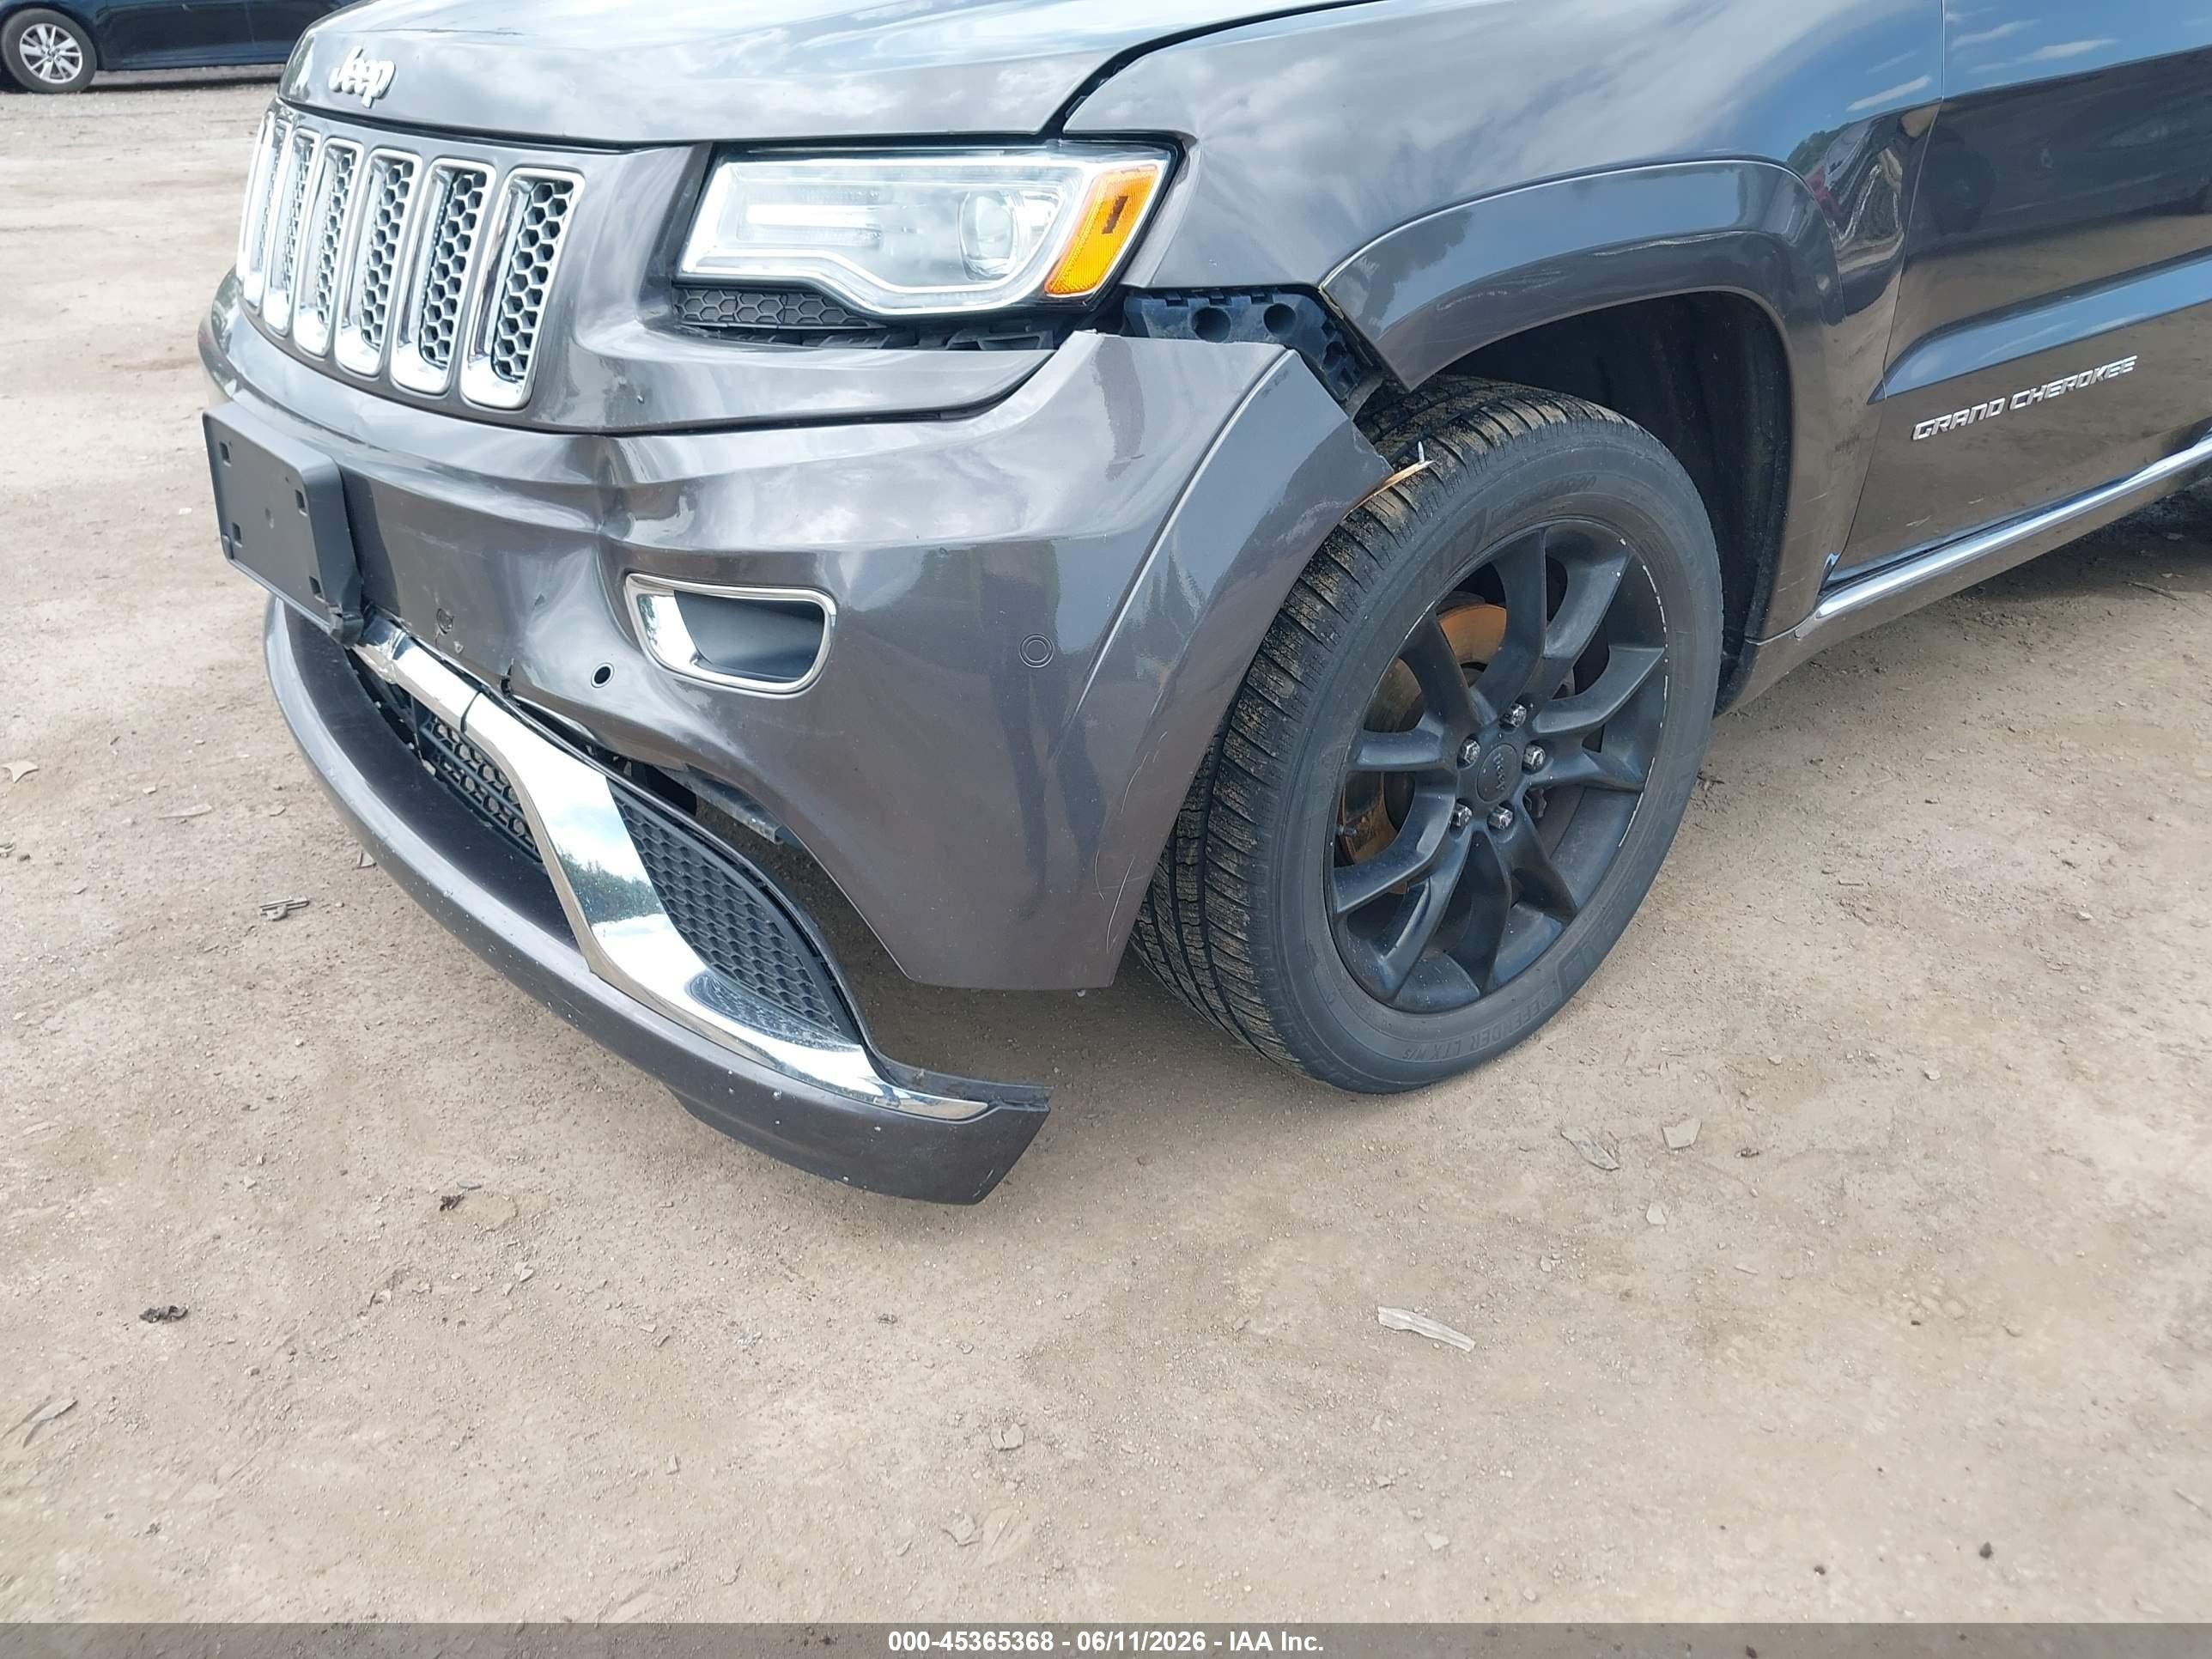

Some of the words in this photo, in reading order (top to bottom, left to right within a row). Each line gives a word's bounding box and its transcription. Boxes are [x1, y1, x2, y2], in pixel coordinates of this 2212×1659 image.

[329, 46, 396, 108] Jeep
[1911, 397, 2005, 440] GRAND
[2008, 355, 2137, 410] CHEROKEE
